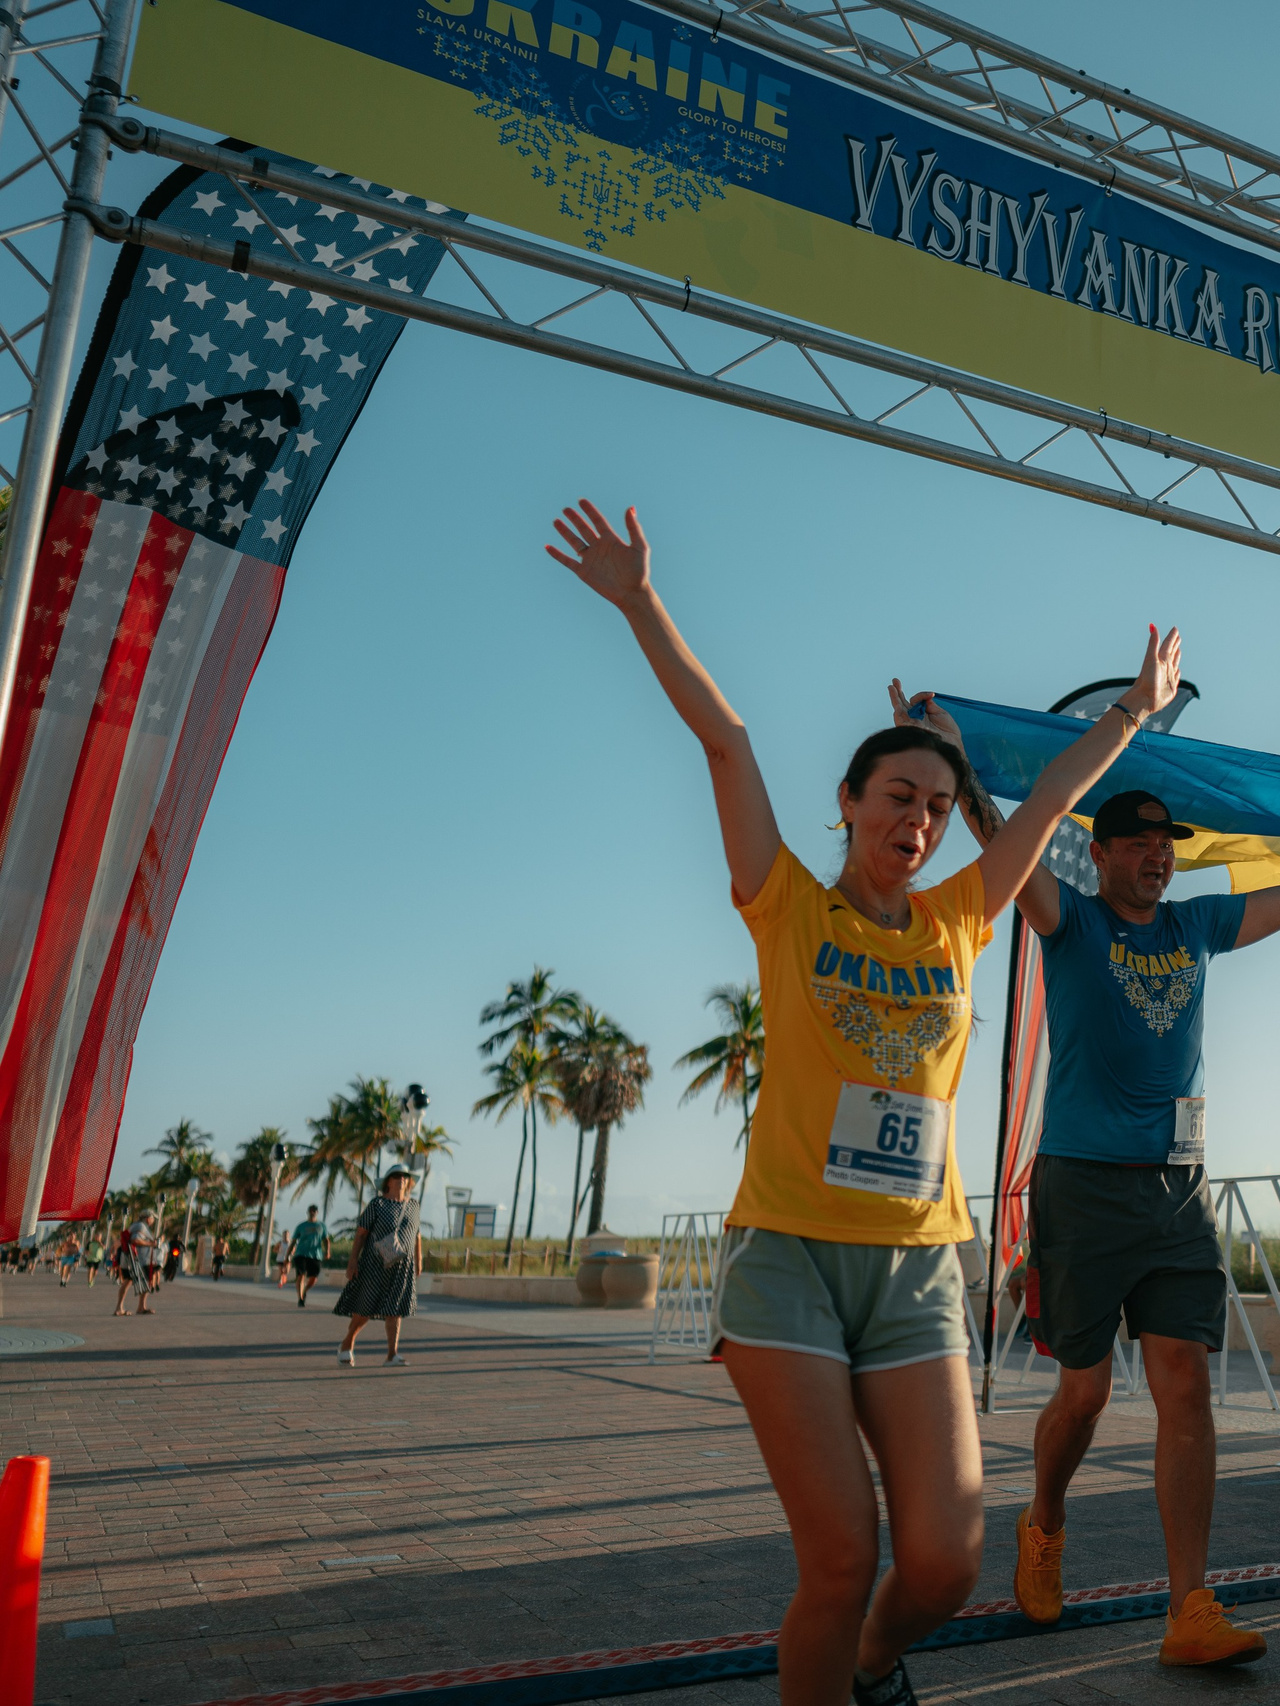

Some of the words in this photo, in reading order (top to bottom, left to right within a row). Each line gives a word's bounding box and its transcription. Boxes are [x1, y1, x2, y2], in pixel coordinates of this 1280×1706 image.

[416, 8, 467, 35] SLAVA
[473, 28, 539, 63] UKRAINI!
[424, 0, 791, 139] KRAINE
[677, 106, 719, 127] GLORY
[721, 121, 737, 134] TO
[740, 128, 787, 154] HEROES!
[846, 133, 1232, 355] VYSHYVANKA
[814, 941, 965, 997] UKRAIN
[876, 1112, 923, 1157] 65
